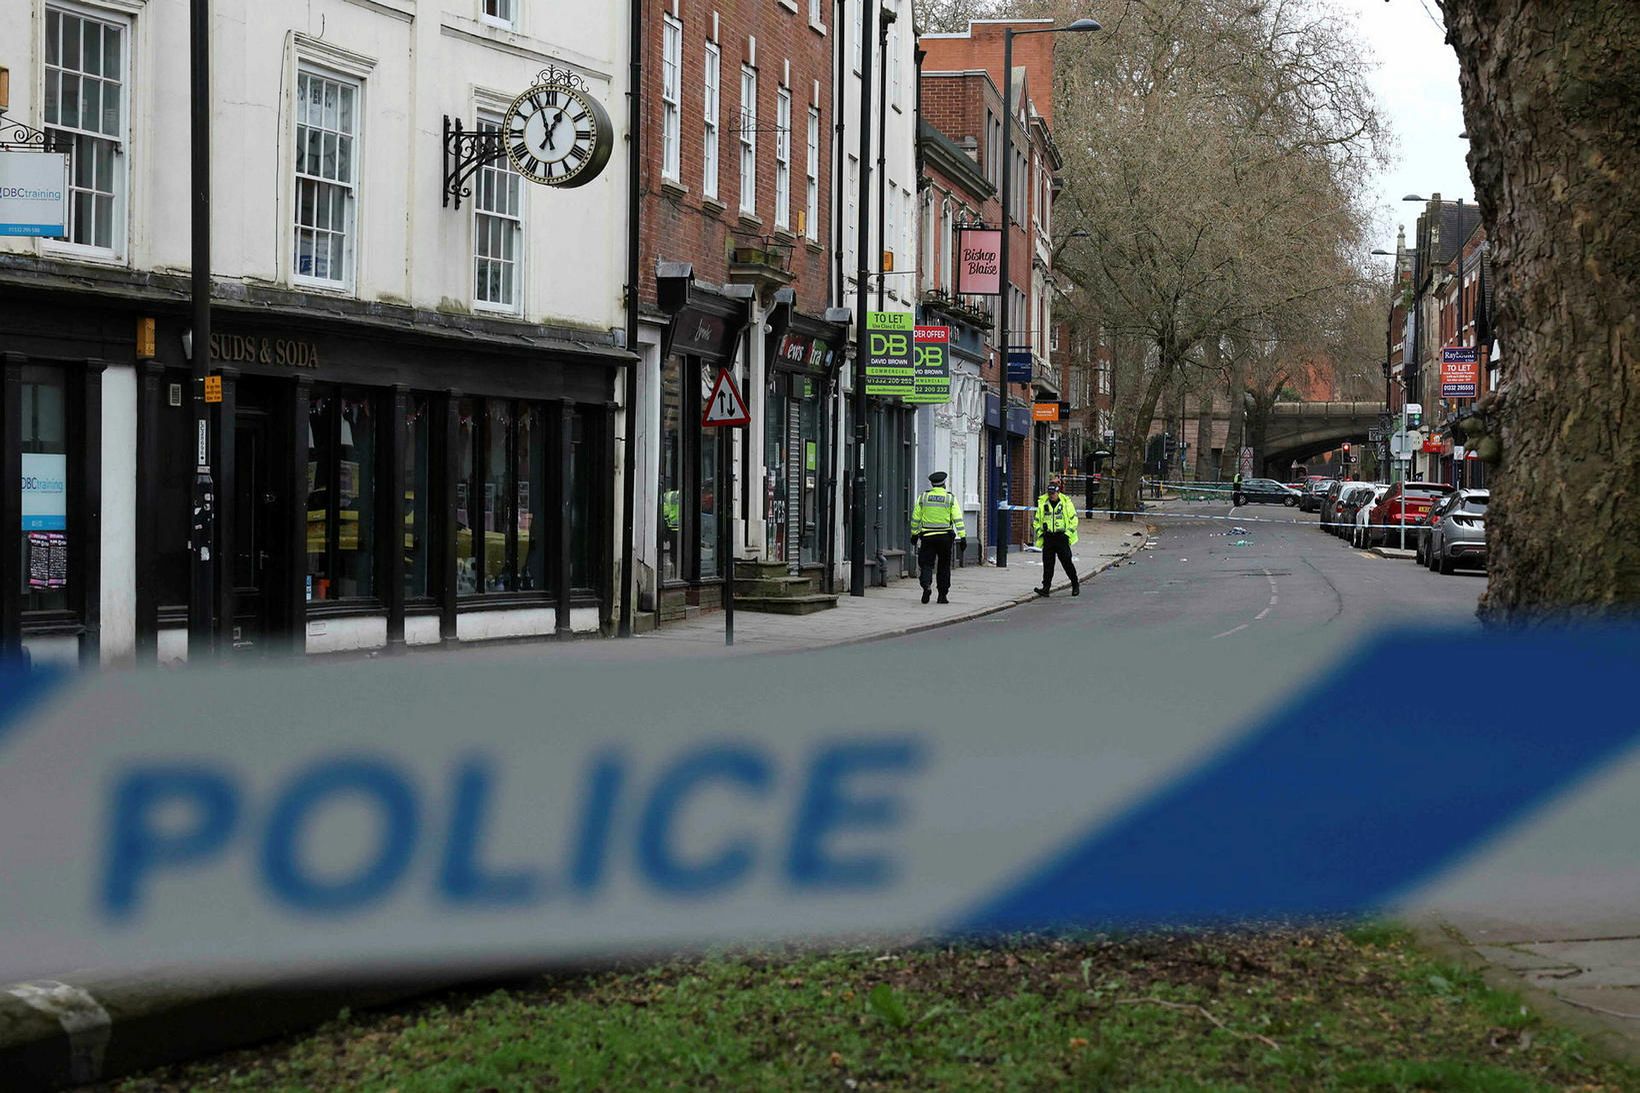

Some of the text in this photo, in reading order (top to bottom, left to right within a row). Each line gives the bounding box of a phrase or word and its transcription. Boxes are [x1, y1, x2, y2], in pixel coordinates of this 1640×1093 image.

[964, 249, 997, 263] Bishop
[968, 262, 998, 275] Blaise
[874, 313, 904, 324] TO LET
[914, 330, 946, 339] DER OFFER
[210, 333, 319, 367] SUDS & SODA
[870, 334, 908, 356] DB
[1447, 364, 1472, 372] TO LET
[96, 736, 924, 922] POLICE
